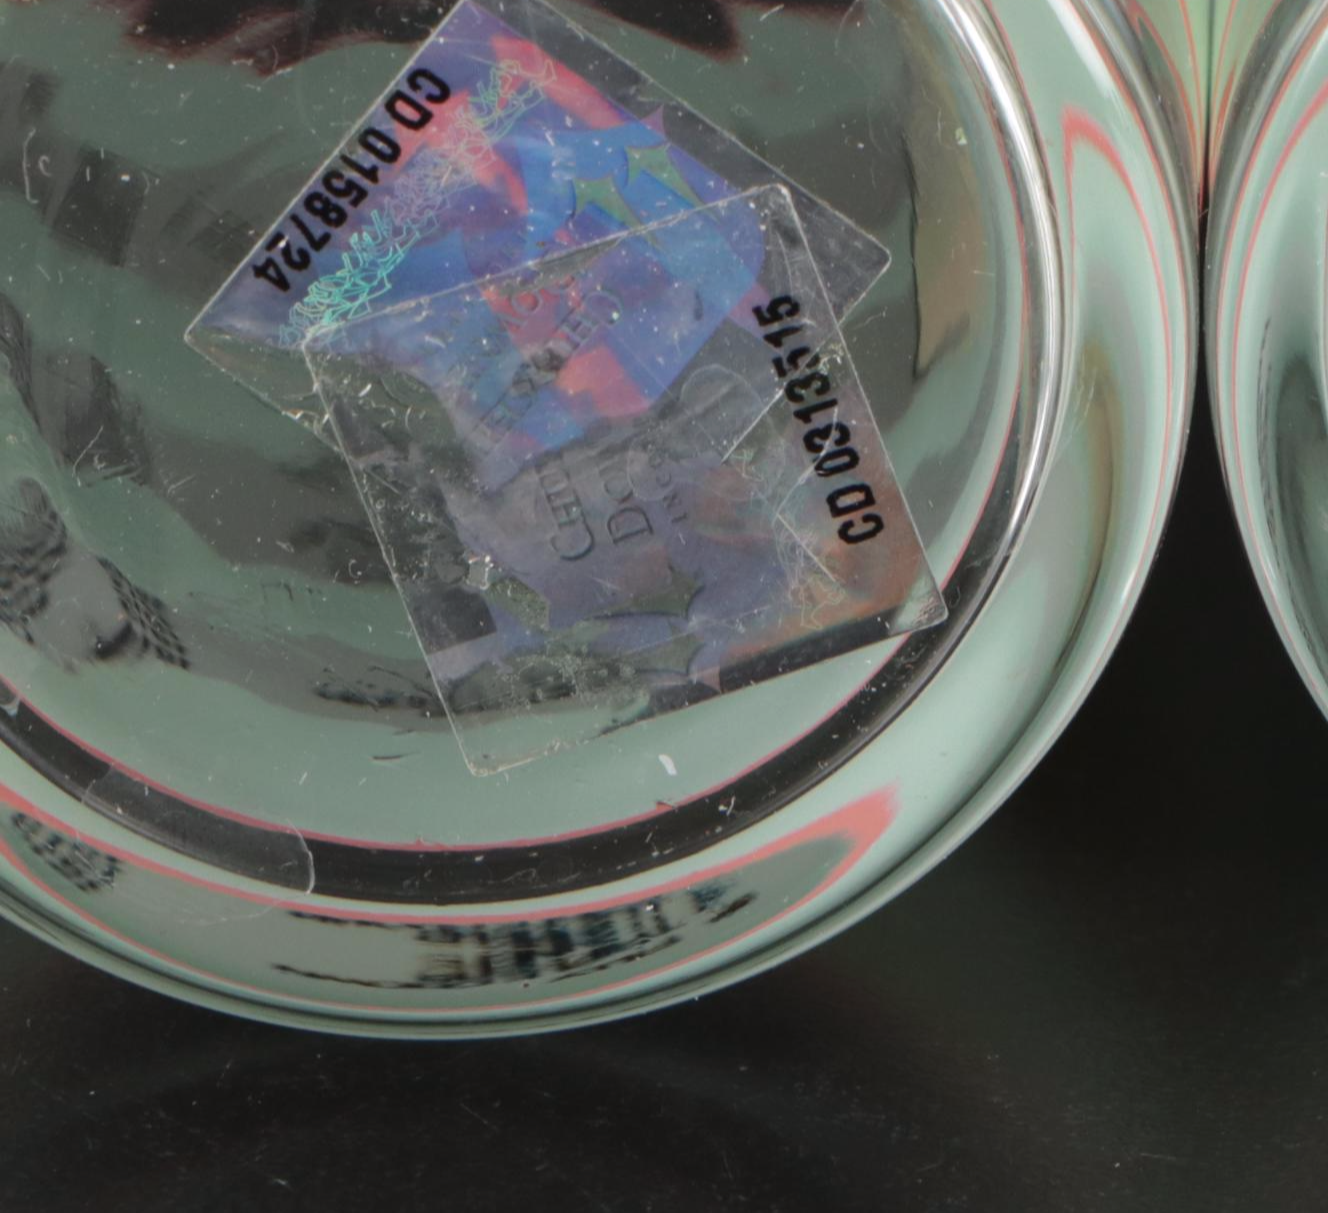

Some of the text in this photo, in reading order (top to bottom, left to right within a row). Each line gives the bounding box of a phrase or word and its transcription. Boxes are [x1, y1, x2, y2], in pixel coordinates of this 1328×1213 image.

[251, 67, 452, 293] CD 0158724
[751, 293, 884, 546] CD 0313515
